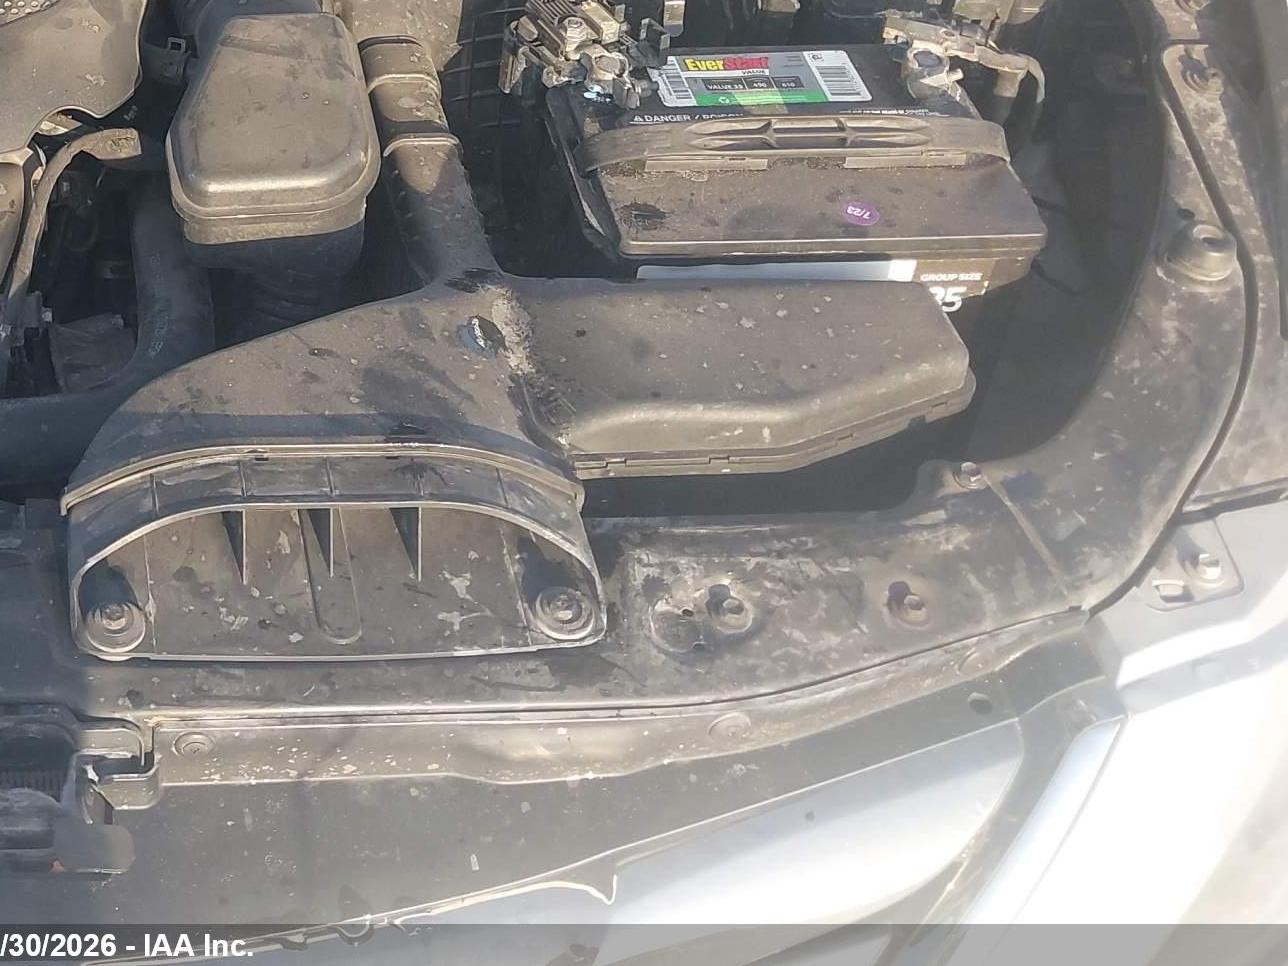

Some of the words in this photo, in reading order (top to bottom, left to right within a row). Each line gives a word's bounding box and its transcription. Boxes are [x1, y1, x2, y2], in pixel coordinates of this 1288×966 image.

[685, 57, 769, 71] EverStart
[644, 114, 691, 122] DANGER
[847, 206, 871, 219] 7/23
[920, 273, 958, 282] GROUP
[958, 272, 983, 282] SIZE
